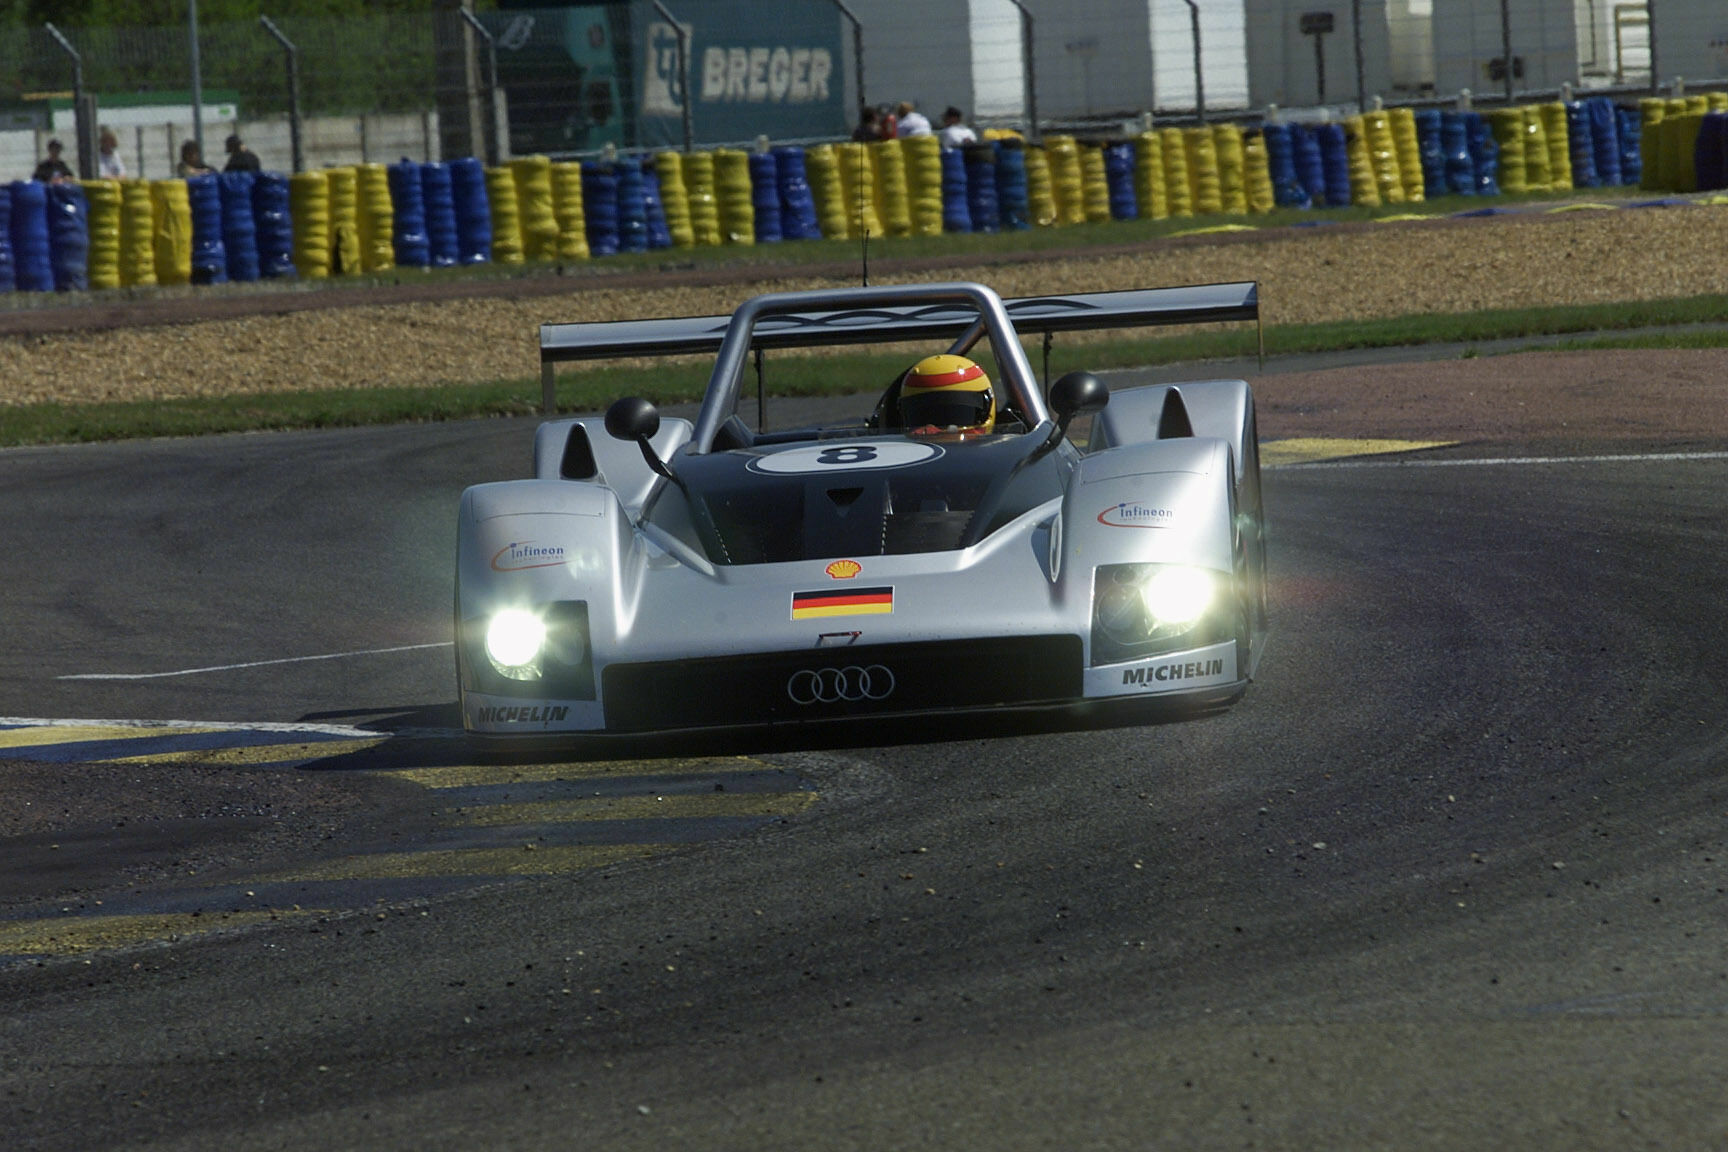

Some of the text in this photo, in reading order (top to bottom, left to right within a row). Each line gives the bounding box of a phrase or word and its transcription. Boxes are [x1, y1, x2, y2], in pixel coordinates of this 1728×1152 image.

[703, 47, 832, 101] BREGER
[817, 445, 878, 465] 8
[1122, 659, 1223, 685] MICHELIN
[478, 706, 569, 723] MICHELIN
